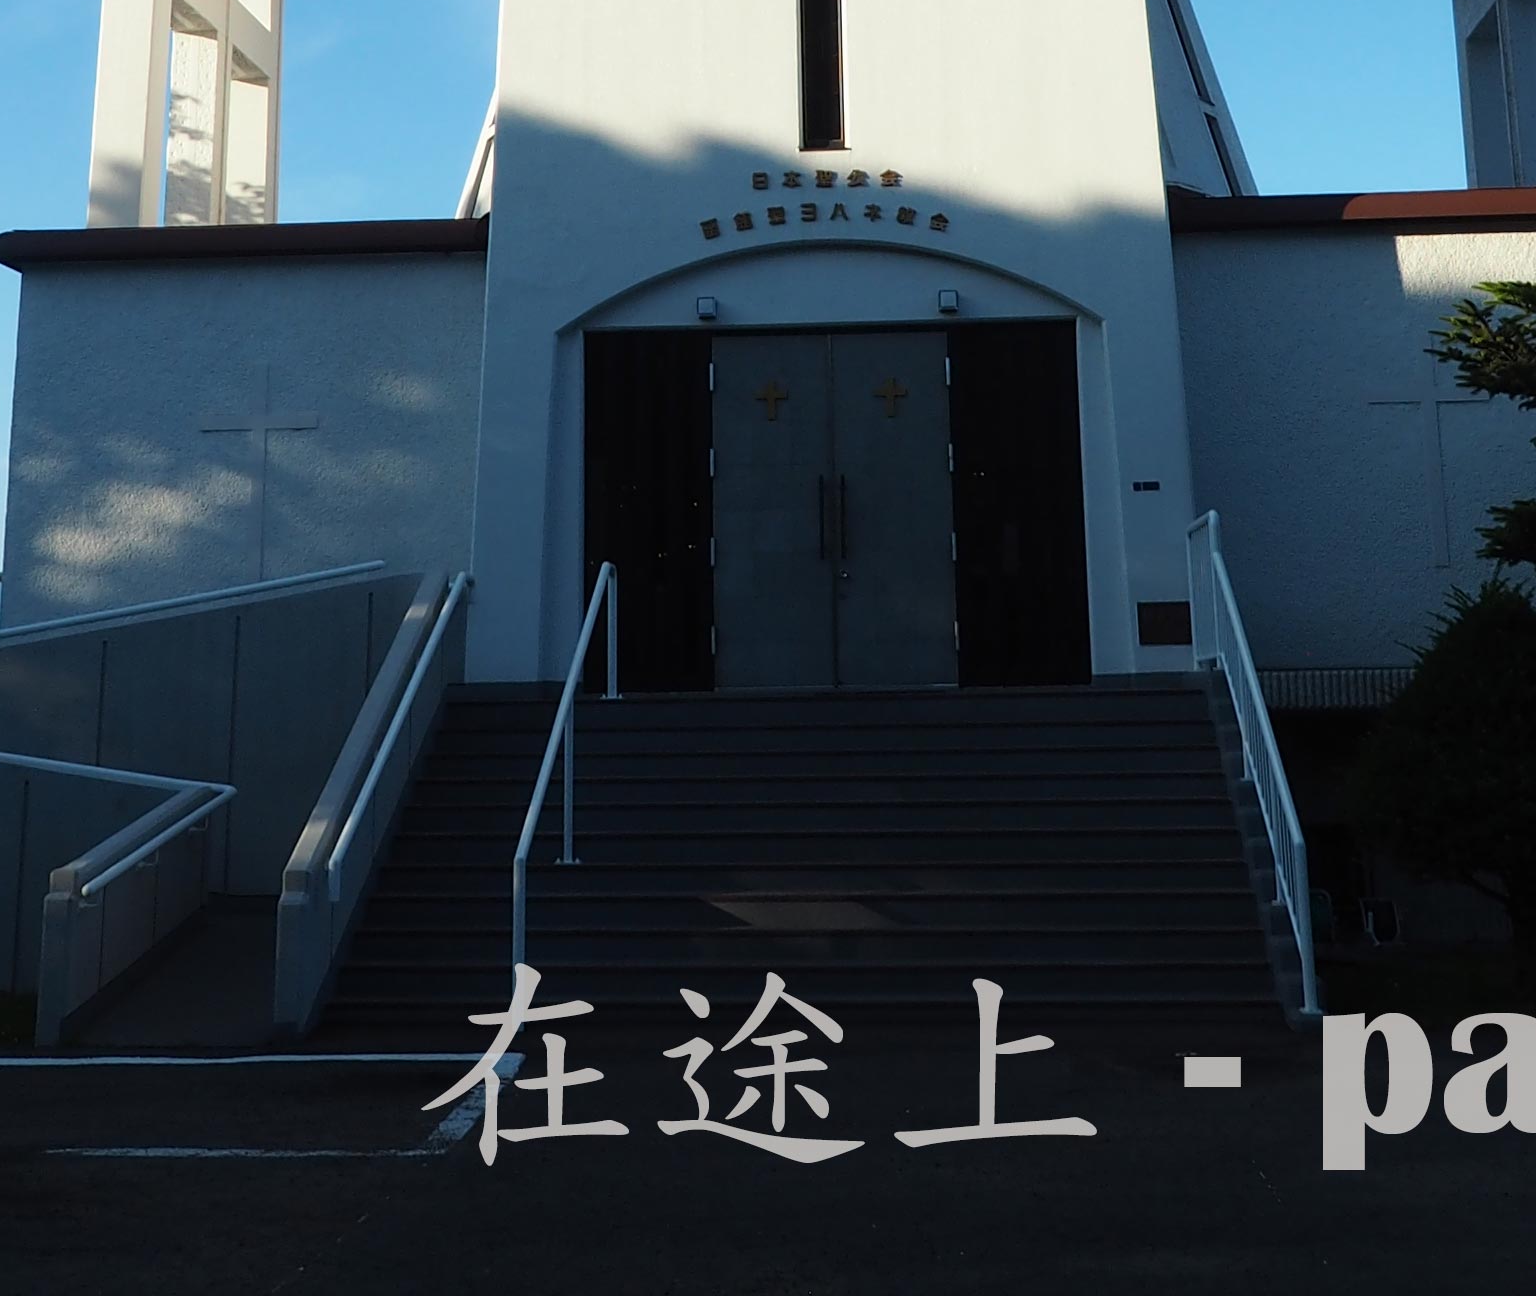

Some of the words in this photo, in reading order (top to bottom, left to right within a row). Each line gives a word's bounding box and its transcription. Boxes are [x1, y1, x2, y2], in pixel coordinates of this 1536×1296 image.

[752, 169, 902, 190] 日本聖公会
